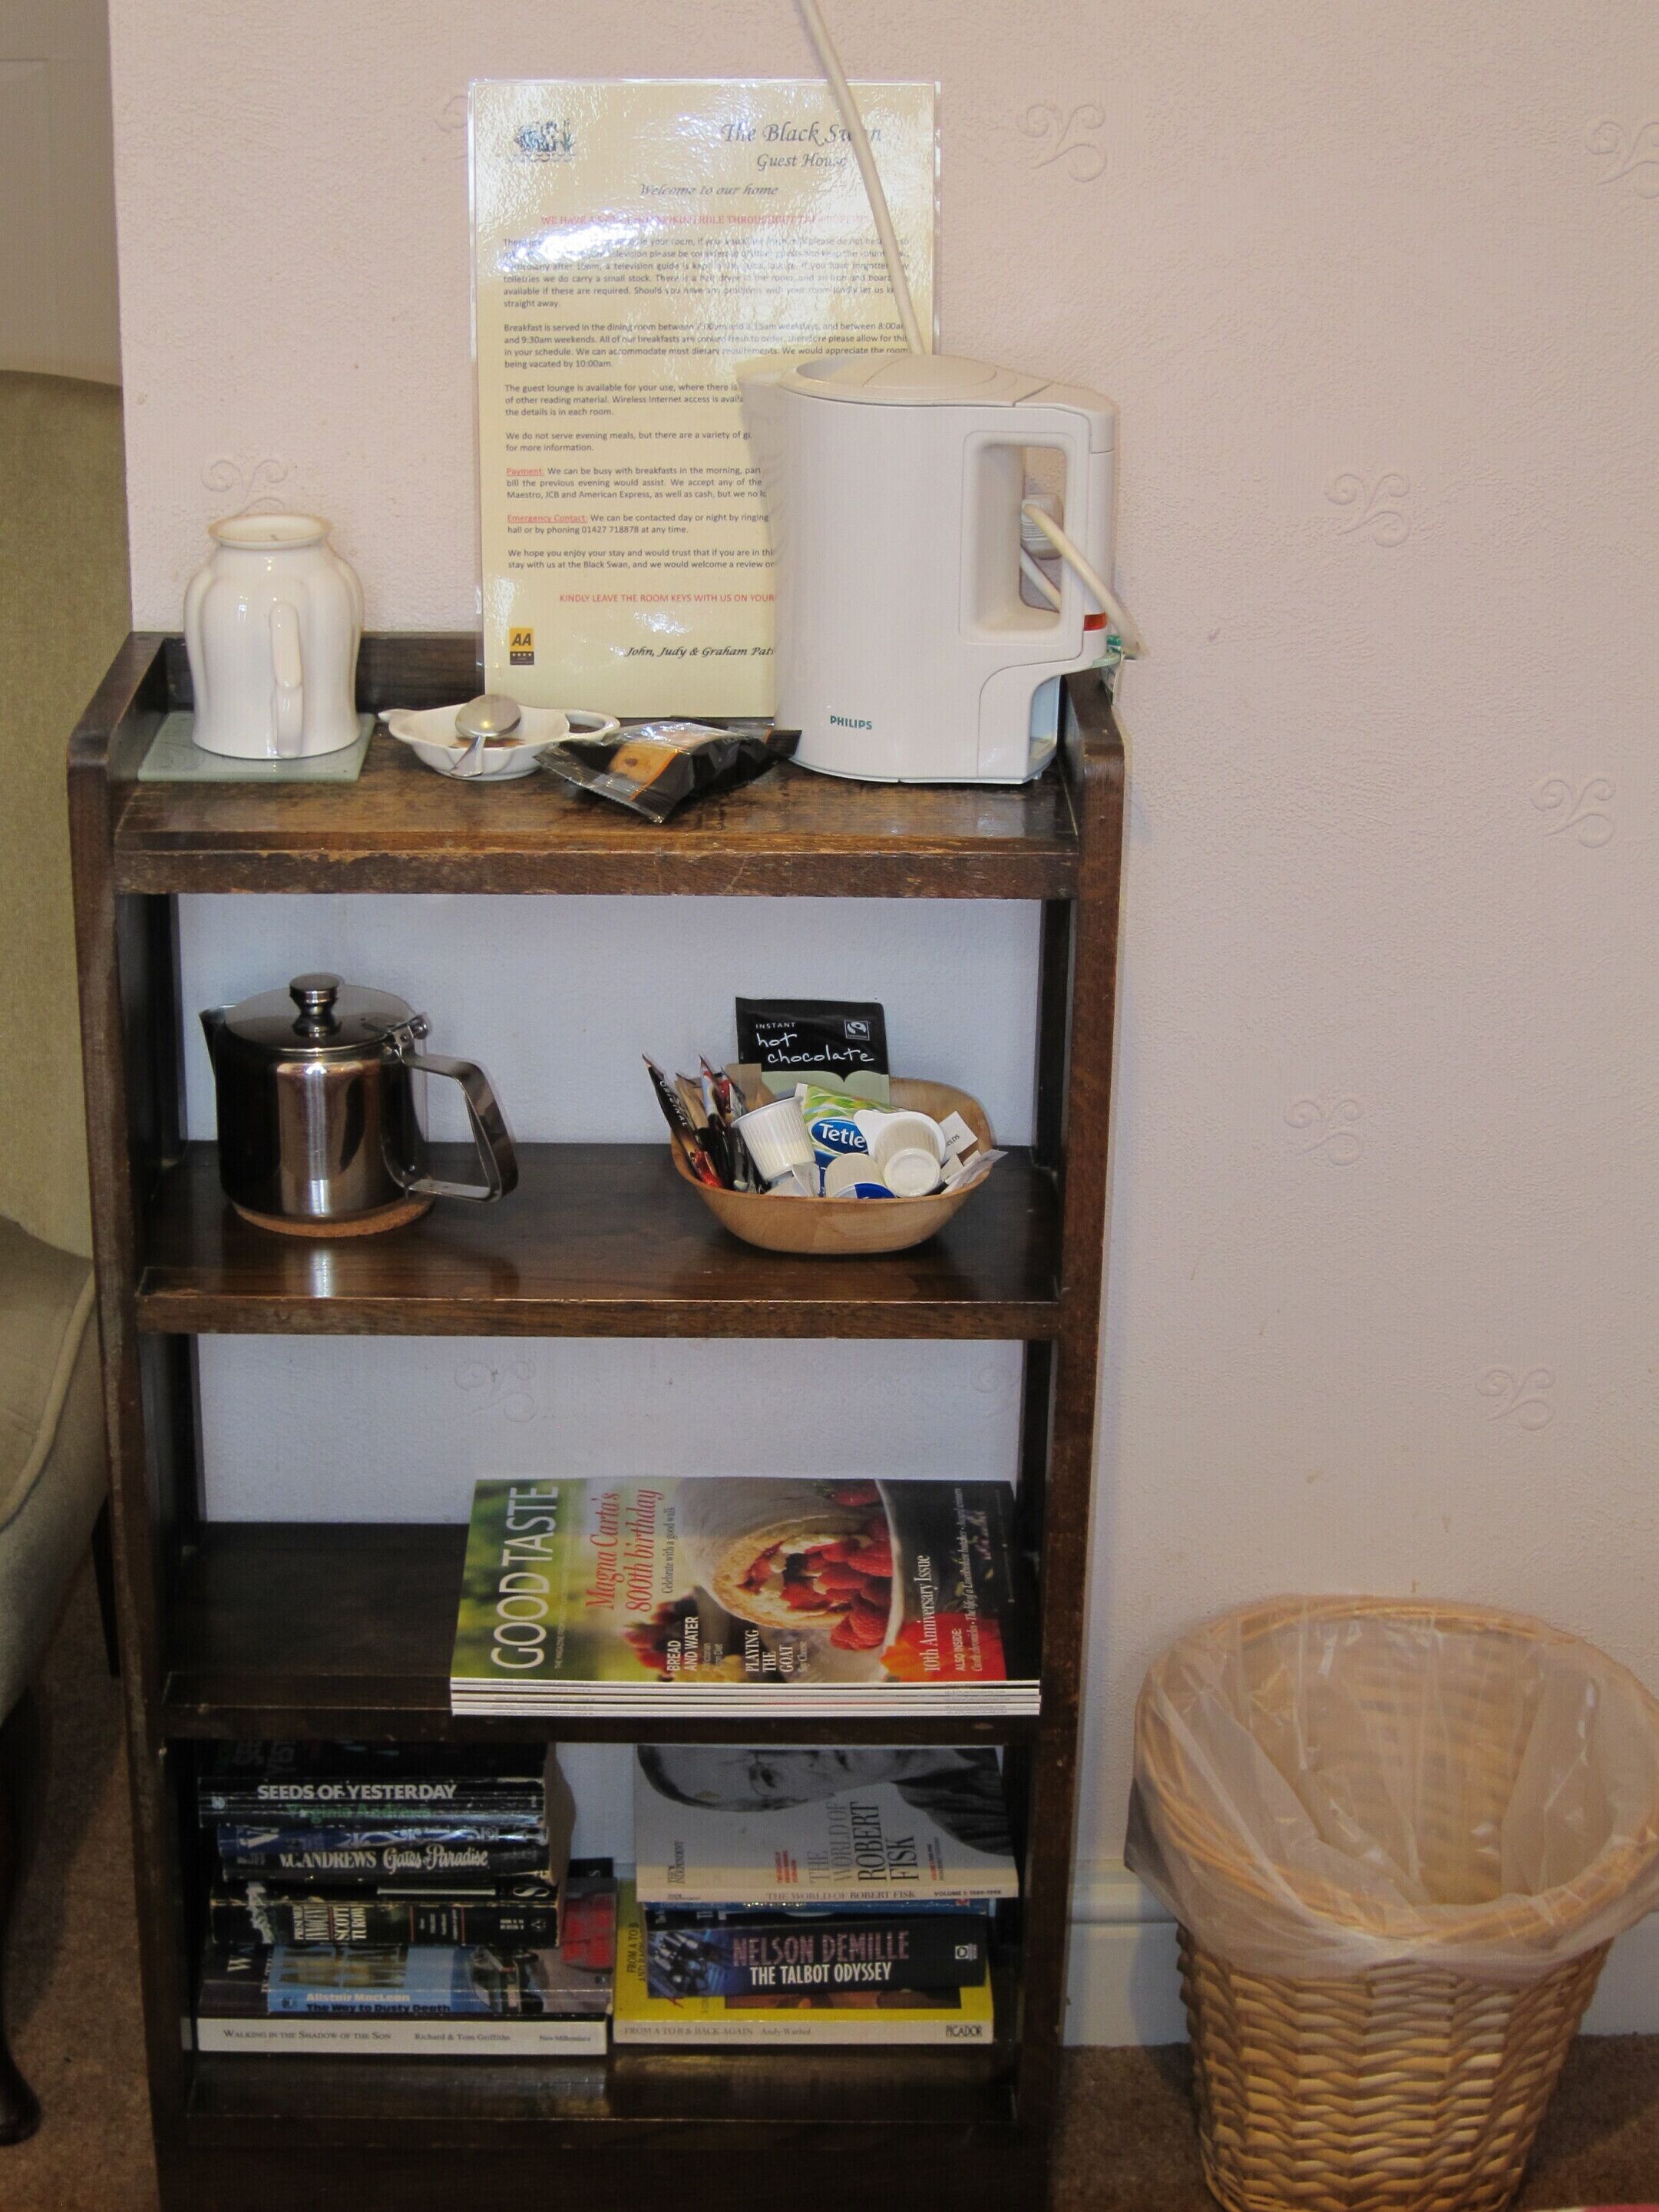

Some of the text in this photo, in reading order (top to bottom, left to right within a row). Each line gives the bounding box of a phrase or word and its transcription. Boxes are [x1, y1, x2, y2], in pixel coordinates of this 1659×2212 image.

[721, 121, 882, 146] The Black Swn
[757, 154, 798, 171] Guest
[640, 184, 779, 195] Welcome to our home
[504, 360, 527, 369] being
[563, 360, 573, 369] by
[507, 514, 550, 524] Emergency
[554, 514, 588, 523] Contact:
[535, 527, 544, 535] by
[547, 527, 580, 535] phoning
[511, 633, 531, 646] AA
[626, 646, 654, 656] John,
[657, 646, 687, 659] Judy
[689, 646, 699, 656] &
[702, 646, 747, 657] Graham
[830, 716, 872, 730] PHILIPS
[757, 1032, 797, 1047] hot
[768, 1045, 874, 1064] chocolate
[501, 1487, 558, 1566] TASTE
[664, 1506, 676, 1523] walk
[663, 1523, 679, 1540] good
[586, 1493, 624, 1610] Magna Carta's
[625, 1489, 664, 1612] 800th birthday
[663, 1546, 675, 1561] with
[662, 1562, 674, 1594] Celebrate
[491, 1572, 550, 1668] GOOD
[914, 1555, 940, 1671] 10th Anniversary Issue
[667, 1640, 681, 1671] BREAD
[684, 1616, 698, 1672] AND WATER
[745, 1629, 759, 1672] PLAYING
[951, 1628, 966, 1671] ALSO INSIDE:
[762, 1651, 777, 1673] THE
[778, 1645, 794, 1673] GOAT
[258, 1784, 457, 1800] SEEDS OF YESTERDAY
[826, 1803, 853, 1881] WORLD OF
[850, 1801, 887, 1882] ROBERT
[384, 1847, 421, 1874] Gates
[425, 1843, 488, 1871] Paradise
[808, 1850, 830, 1883] THE
[885, 1836, 919, 1881] FISK
[768, 1892, 789, 1900] THE
[791, 1892, 831, 1900] WORLD
[334, 1907, 350, 1941] SCOTT
[351, 1907, 367, 1939] TUROW
[732, 1935, 815, 1966] NELSON
[750, 1962, 892, 1986] THE TALBOT ODYSSEY
[307, 1993, 410, 2002] Alistair MacLean
[307, 2004, 330, 2012] The
[332, 2004, 356, 2012] Way
[372, 2004, 409, 2012] Dusty
[413, 2004, 451, 2012] Death
[762, 2027, 781, 2035] Andy
[946, 2024, 983, 2037] PICADOR
